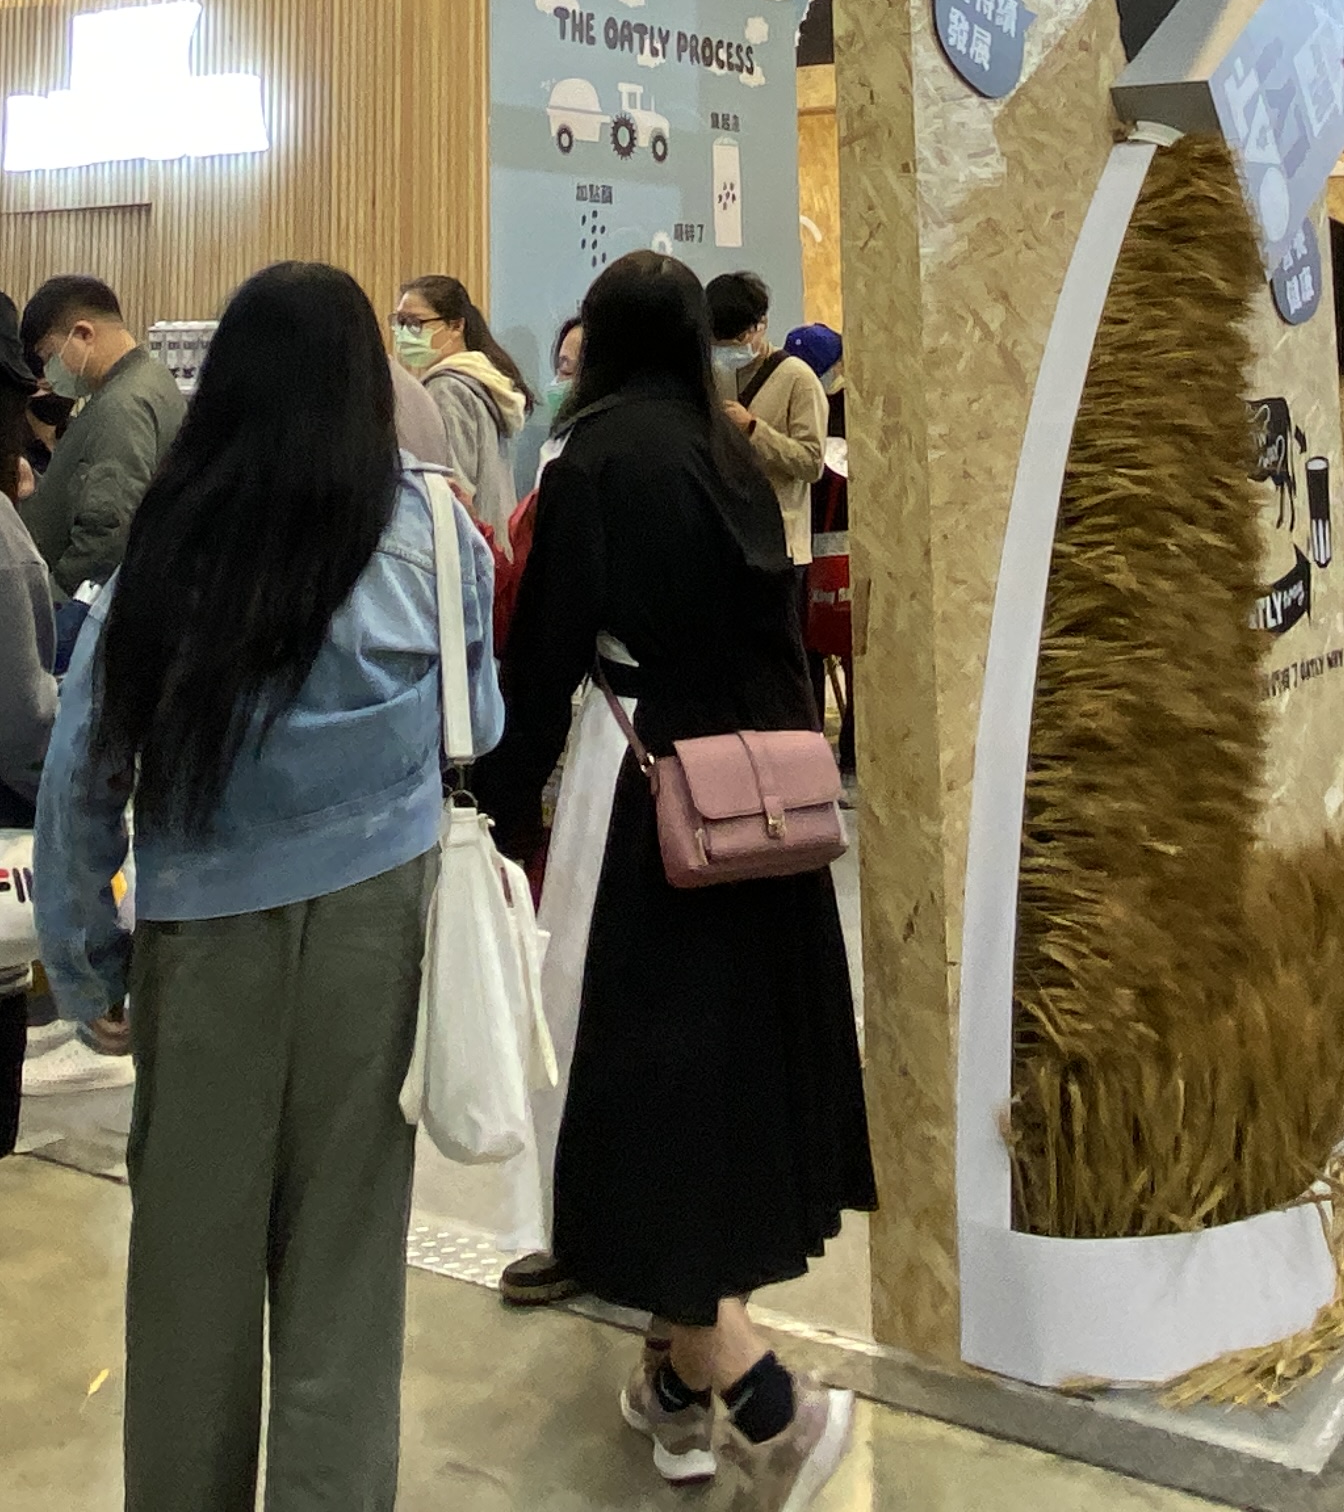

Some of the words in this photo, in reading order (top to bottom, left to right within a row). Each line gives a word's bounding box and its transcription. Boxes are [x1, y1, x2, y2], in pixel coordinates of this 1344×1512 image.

[554, 6, 596, 46] THE
[604, 16, 670, 60] OATLY
[676, 30, 754, 76] PROCESS
